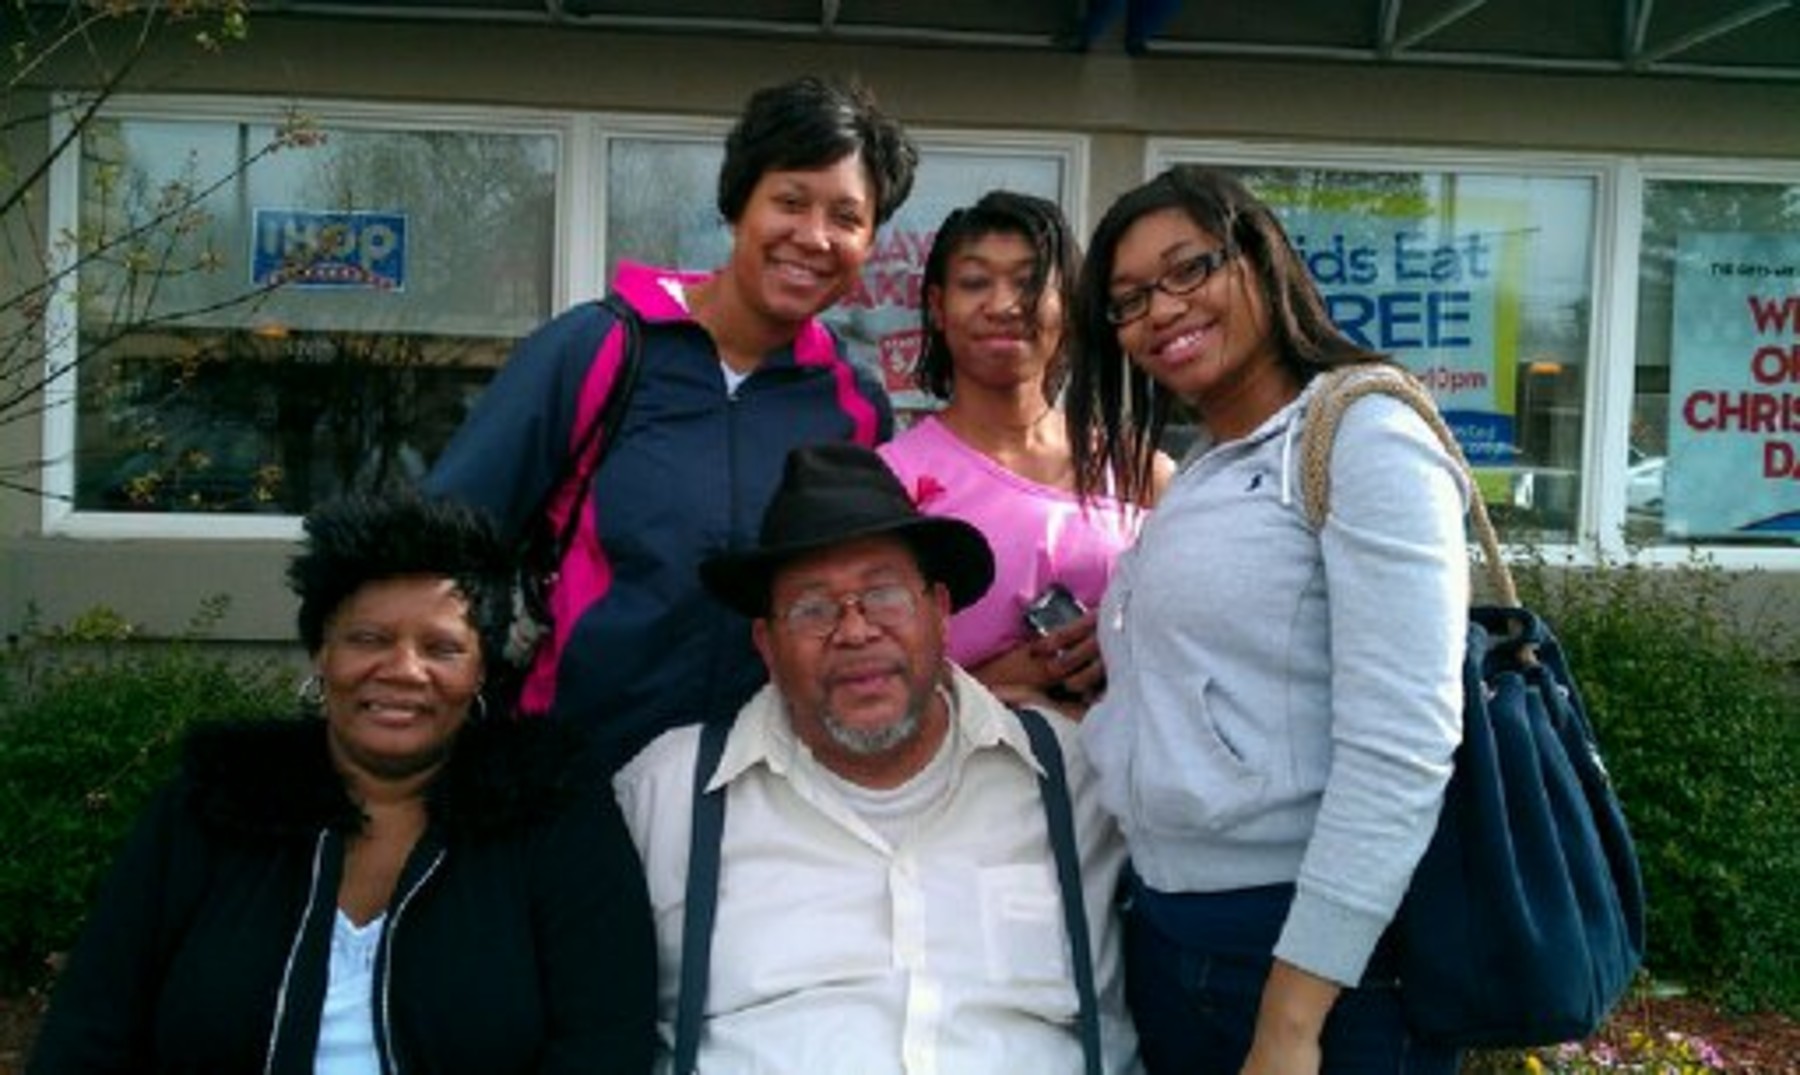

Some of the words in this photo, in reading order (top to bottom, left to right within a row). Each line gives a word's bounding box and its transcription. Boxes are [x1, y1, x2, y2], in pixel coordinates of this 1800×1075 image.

[871, 229, 938, 266] AY
[1395, 230, 1489, 283] Eat
[1747, 295, 1800, 336] W
[1752, 344, 1800, 385] O
